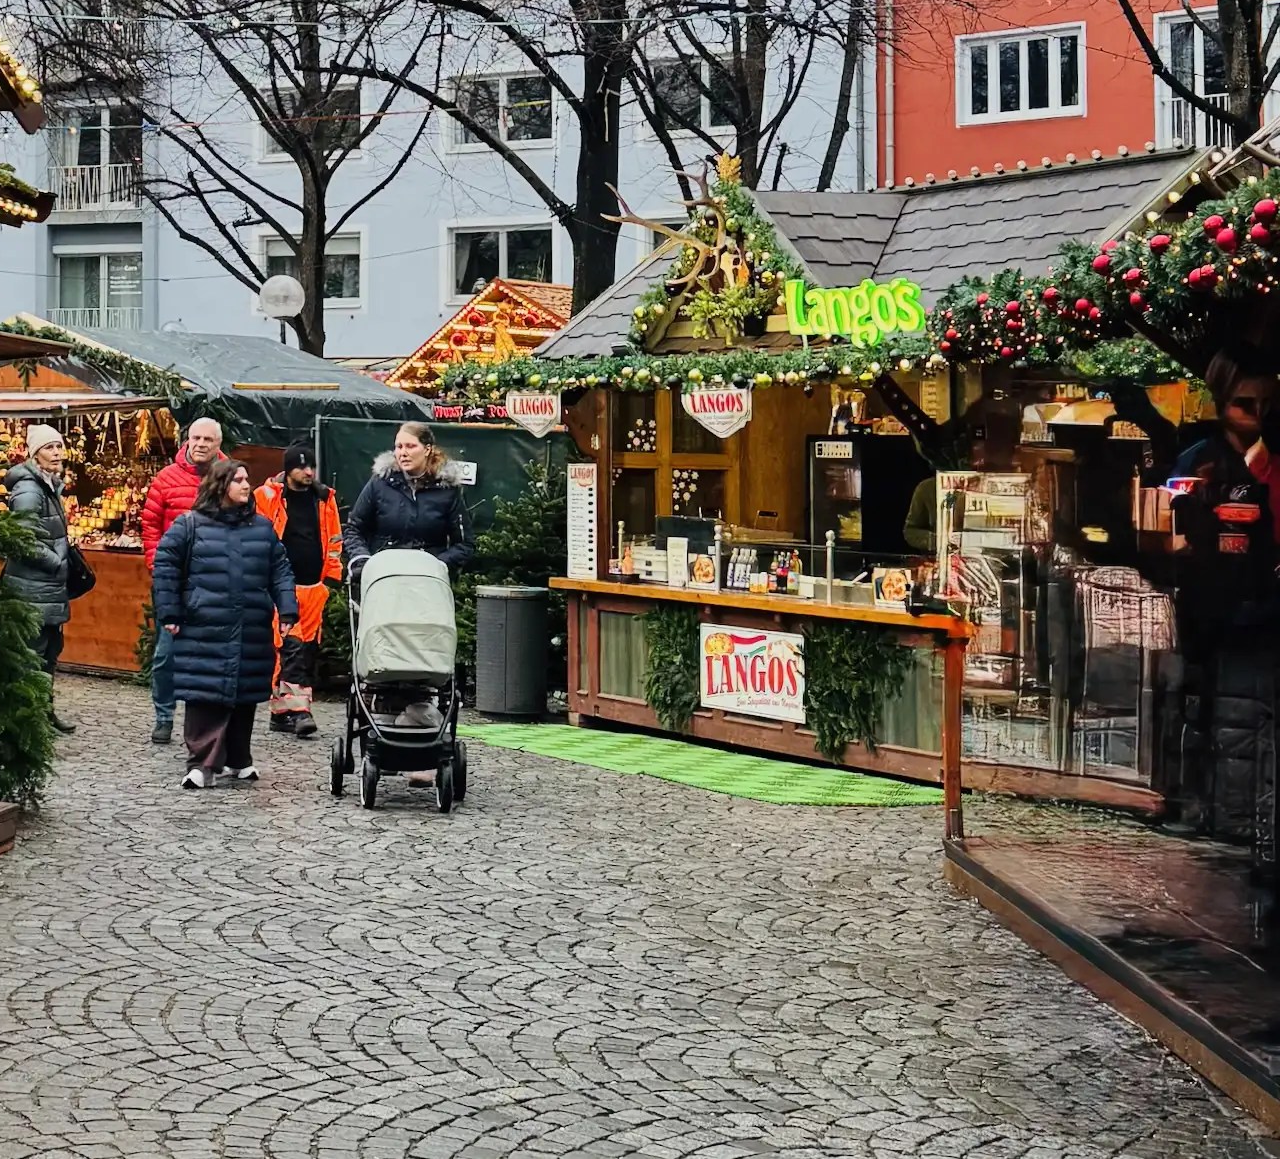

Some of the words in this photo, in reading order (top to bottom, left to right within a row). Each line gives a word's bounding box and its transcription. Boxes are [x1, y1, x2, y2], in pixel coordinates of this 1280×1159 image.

[513, 397, 554, 415] LANGOS
[690, 393, 744, 414] LANGOS
[705, 654, 798, 696] LANGOS
